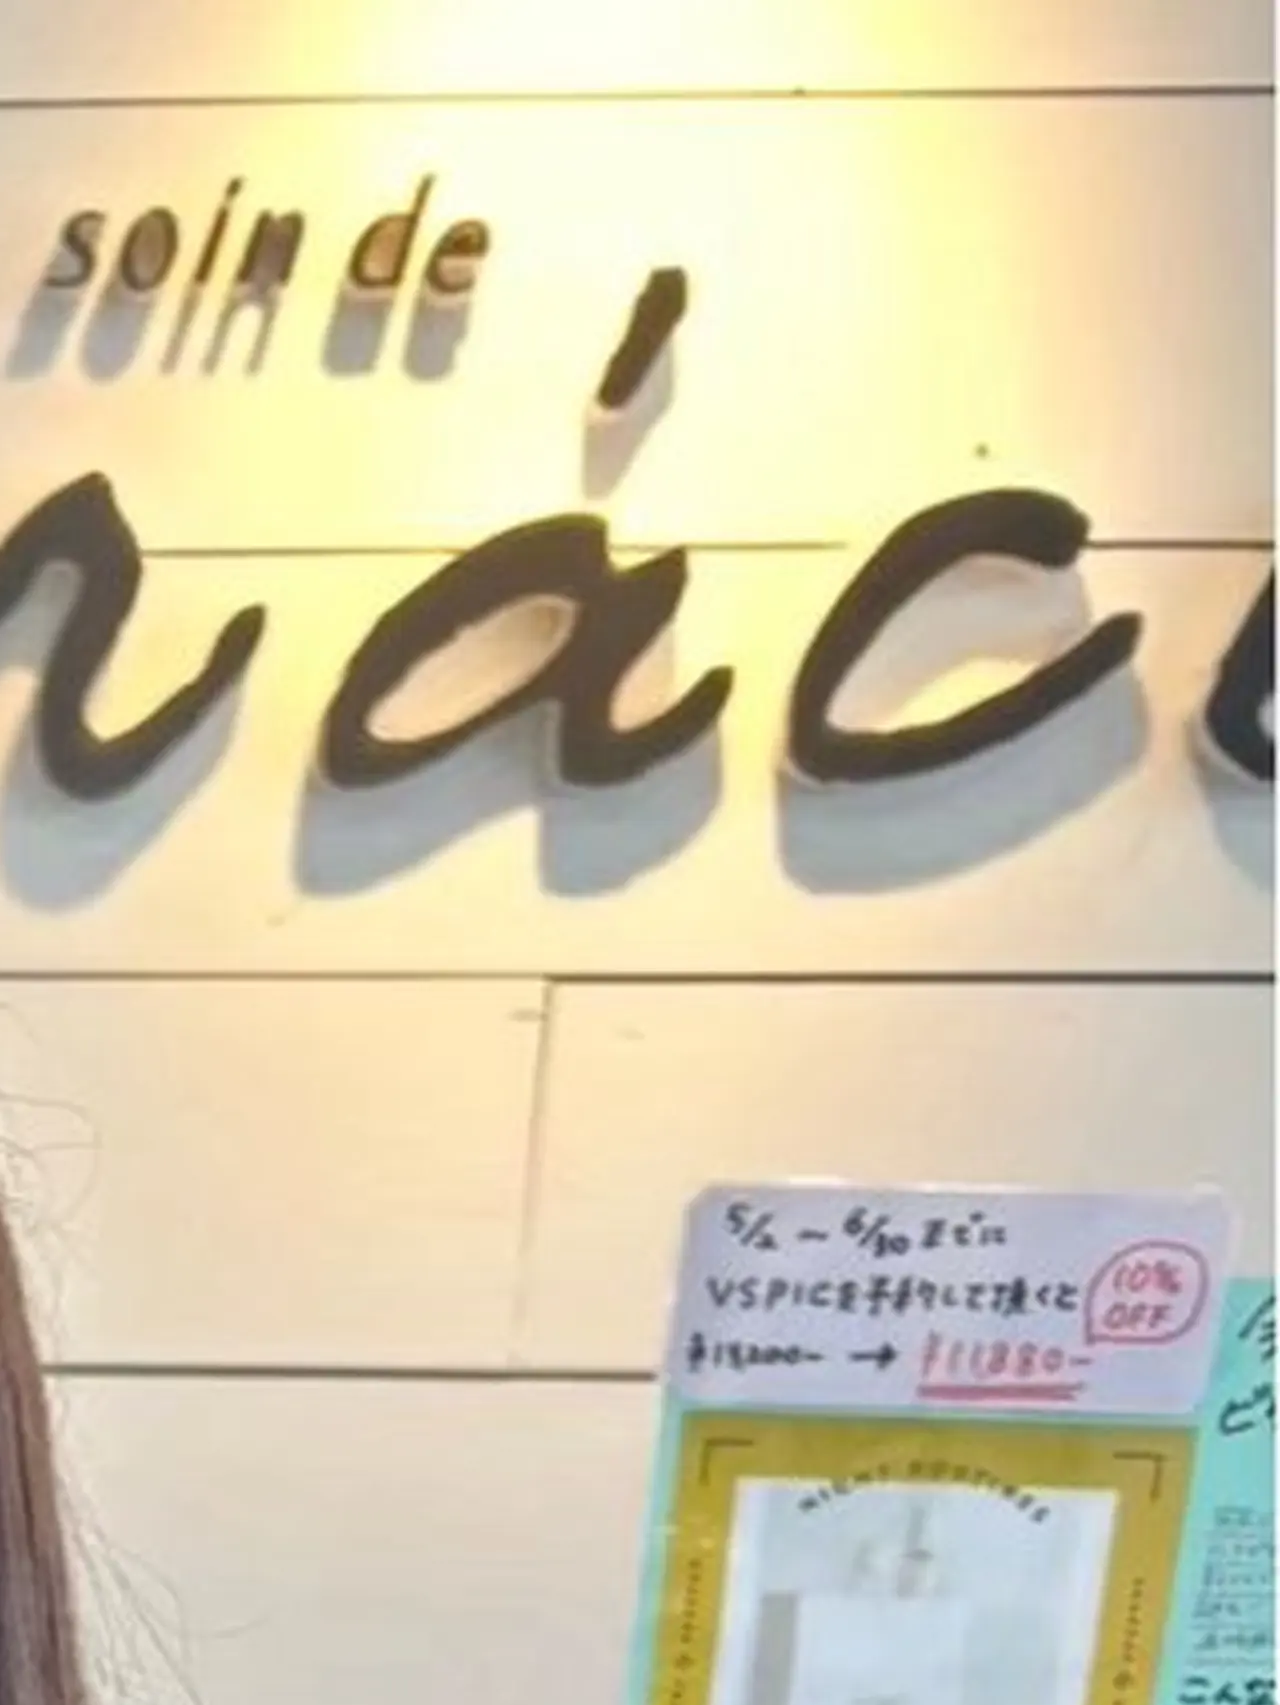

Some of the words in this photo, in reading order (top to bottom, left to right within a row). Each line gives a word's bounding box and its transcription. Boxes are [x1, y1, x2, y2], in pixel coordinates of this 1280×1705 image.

[45, 176, 306, 291] soin
[347, 172, 491, 296] de
[1102, 1302, 1173, 1330] OFF
